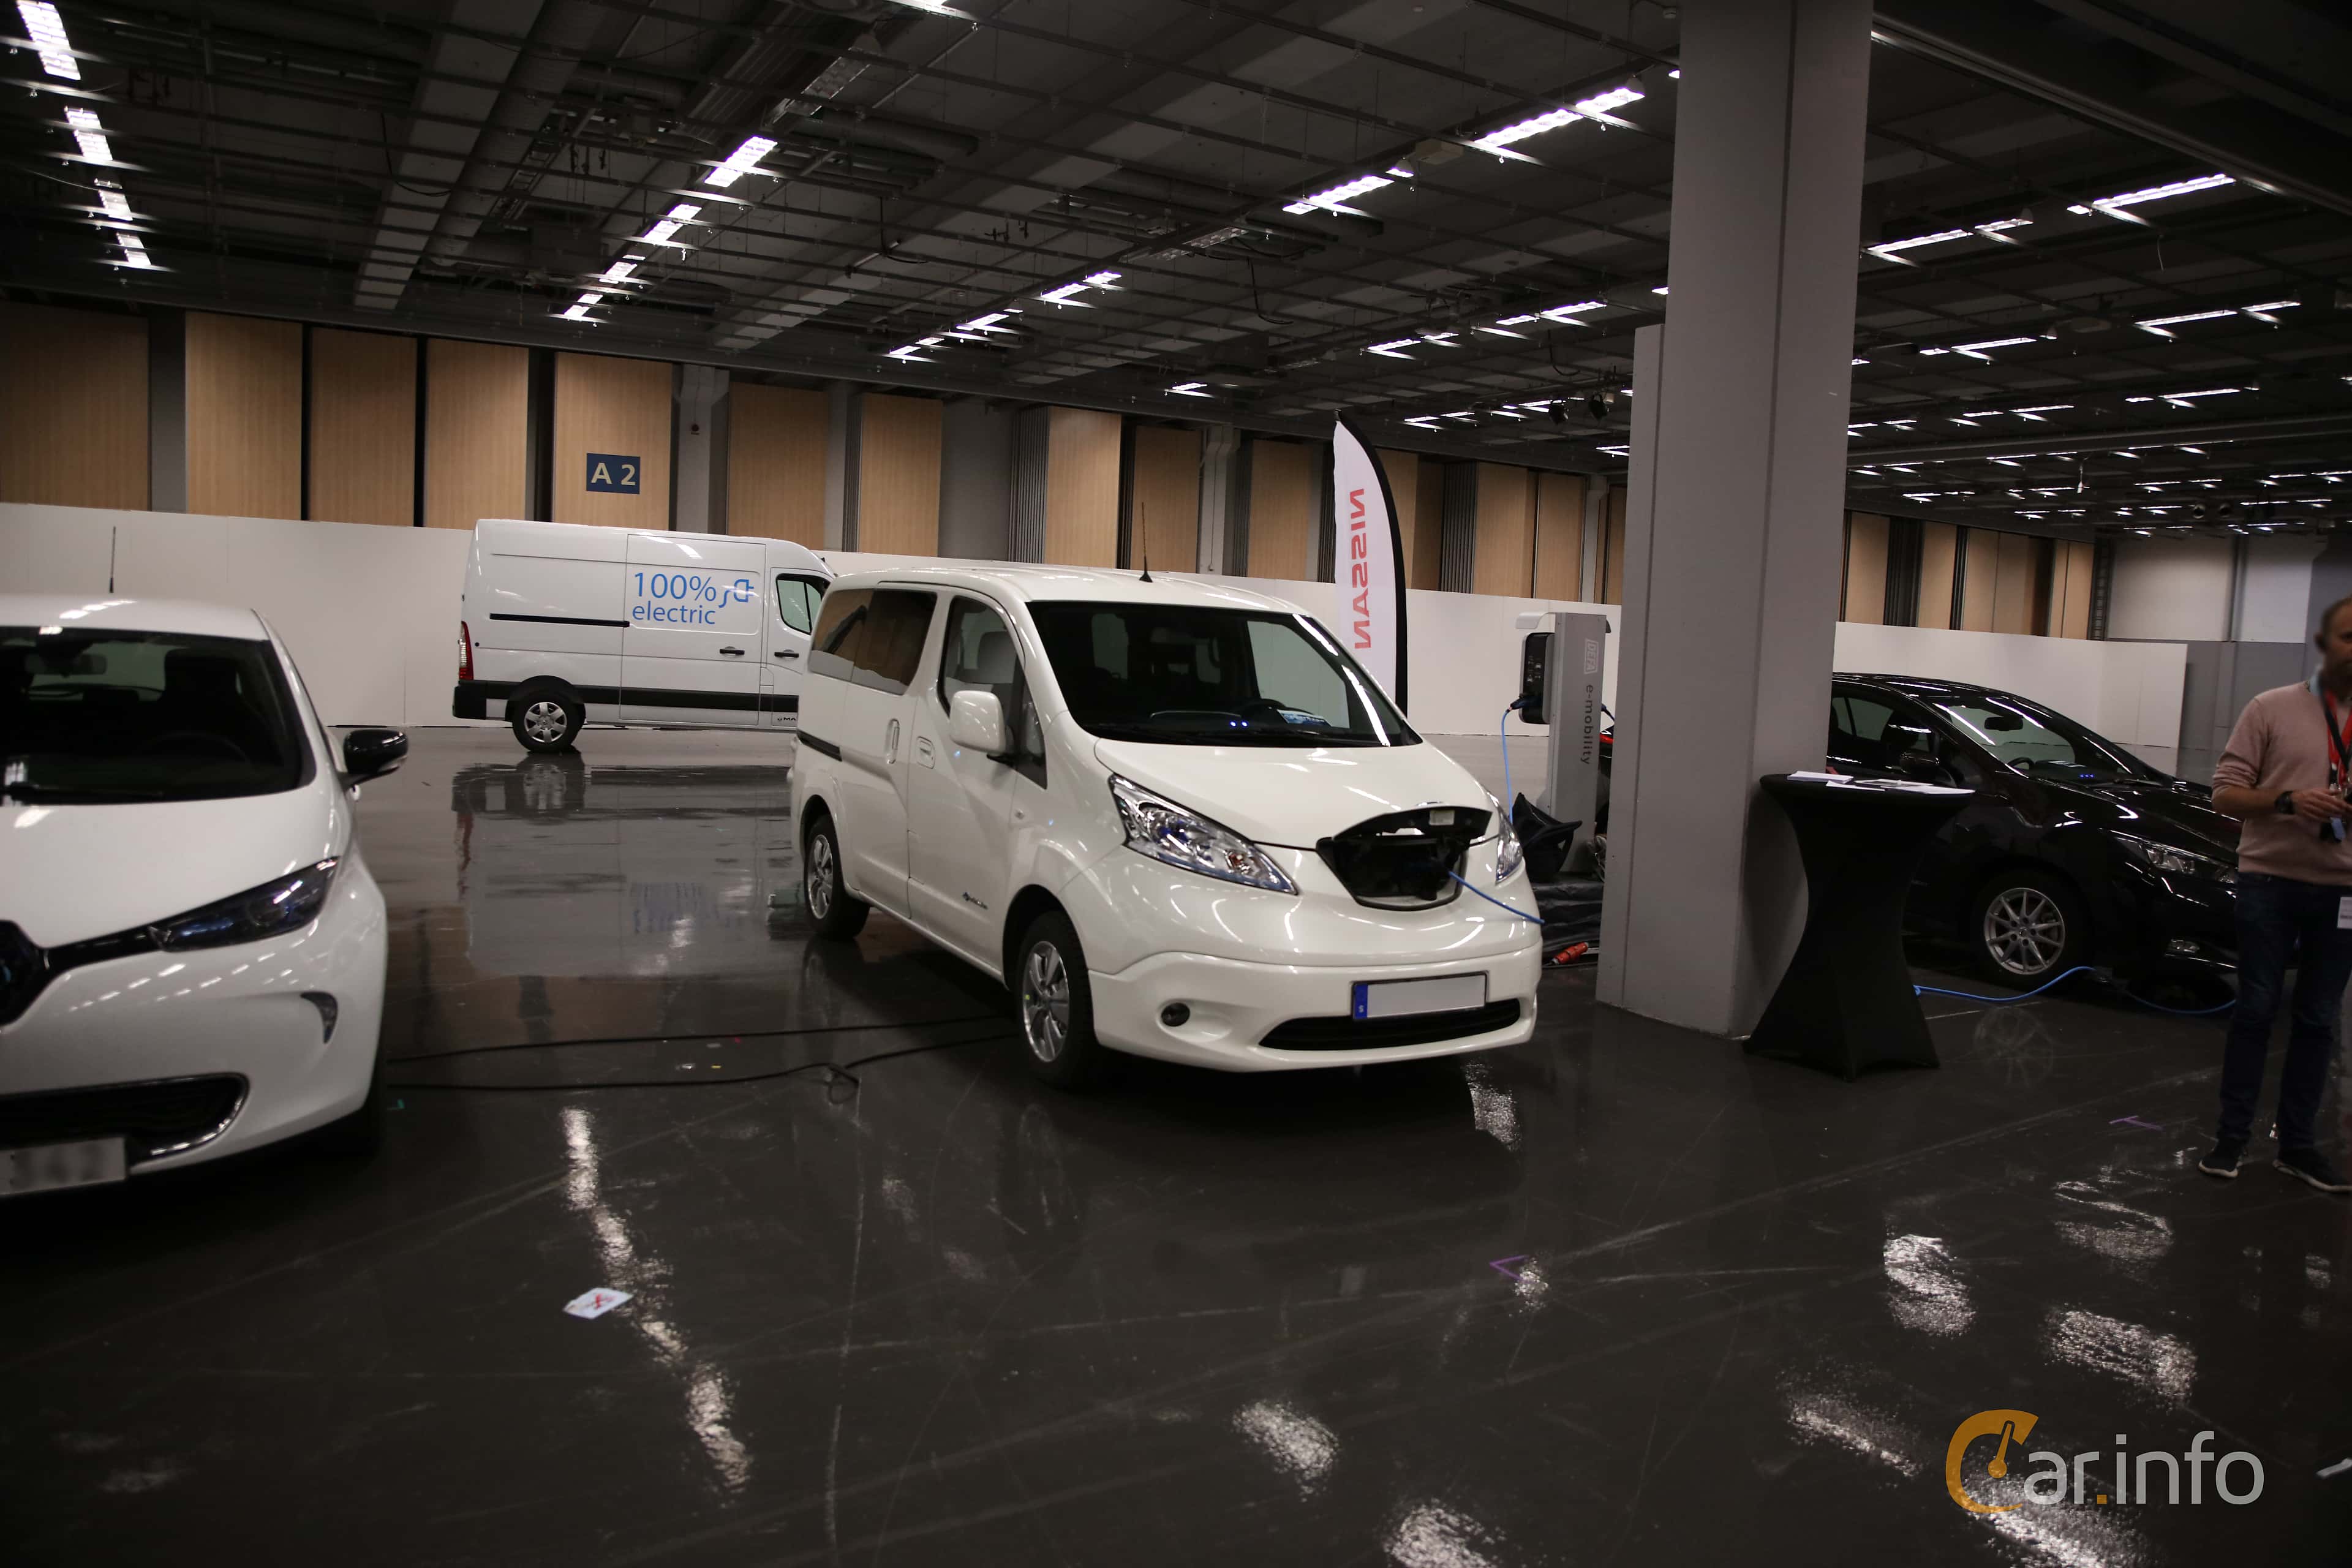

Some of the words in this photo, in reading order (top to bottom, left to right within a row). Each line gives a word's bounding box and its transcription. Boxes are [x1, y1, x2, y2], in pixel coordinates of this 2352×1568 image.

[590, 462, 612, 484] A
[621, 464, 636, 486] 2
[635, 572, 717, 601] 100%
[632, 600, 716, 625] electric
[1580, 684, 1594, 764] e-mobility
